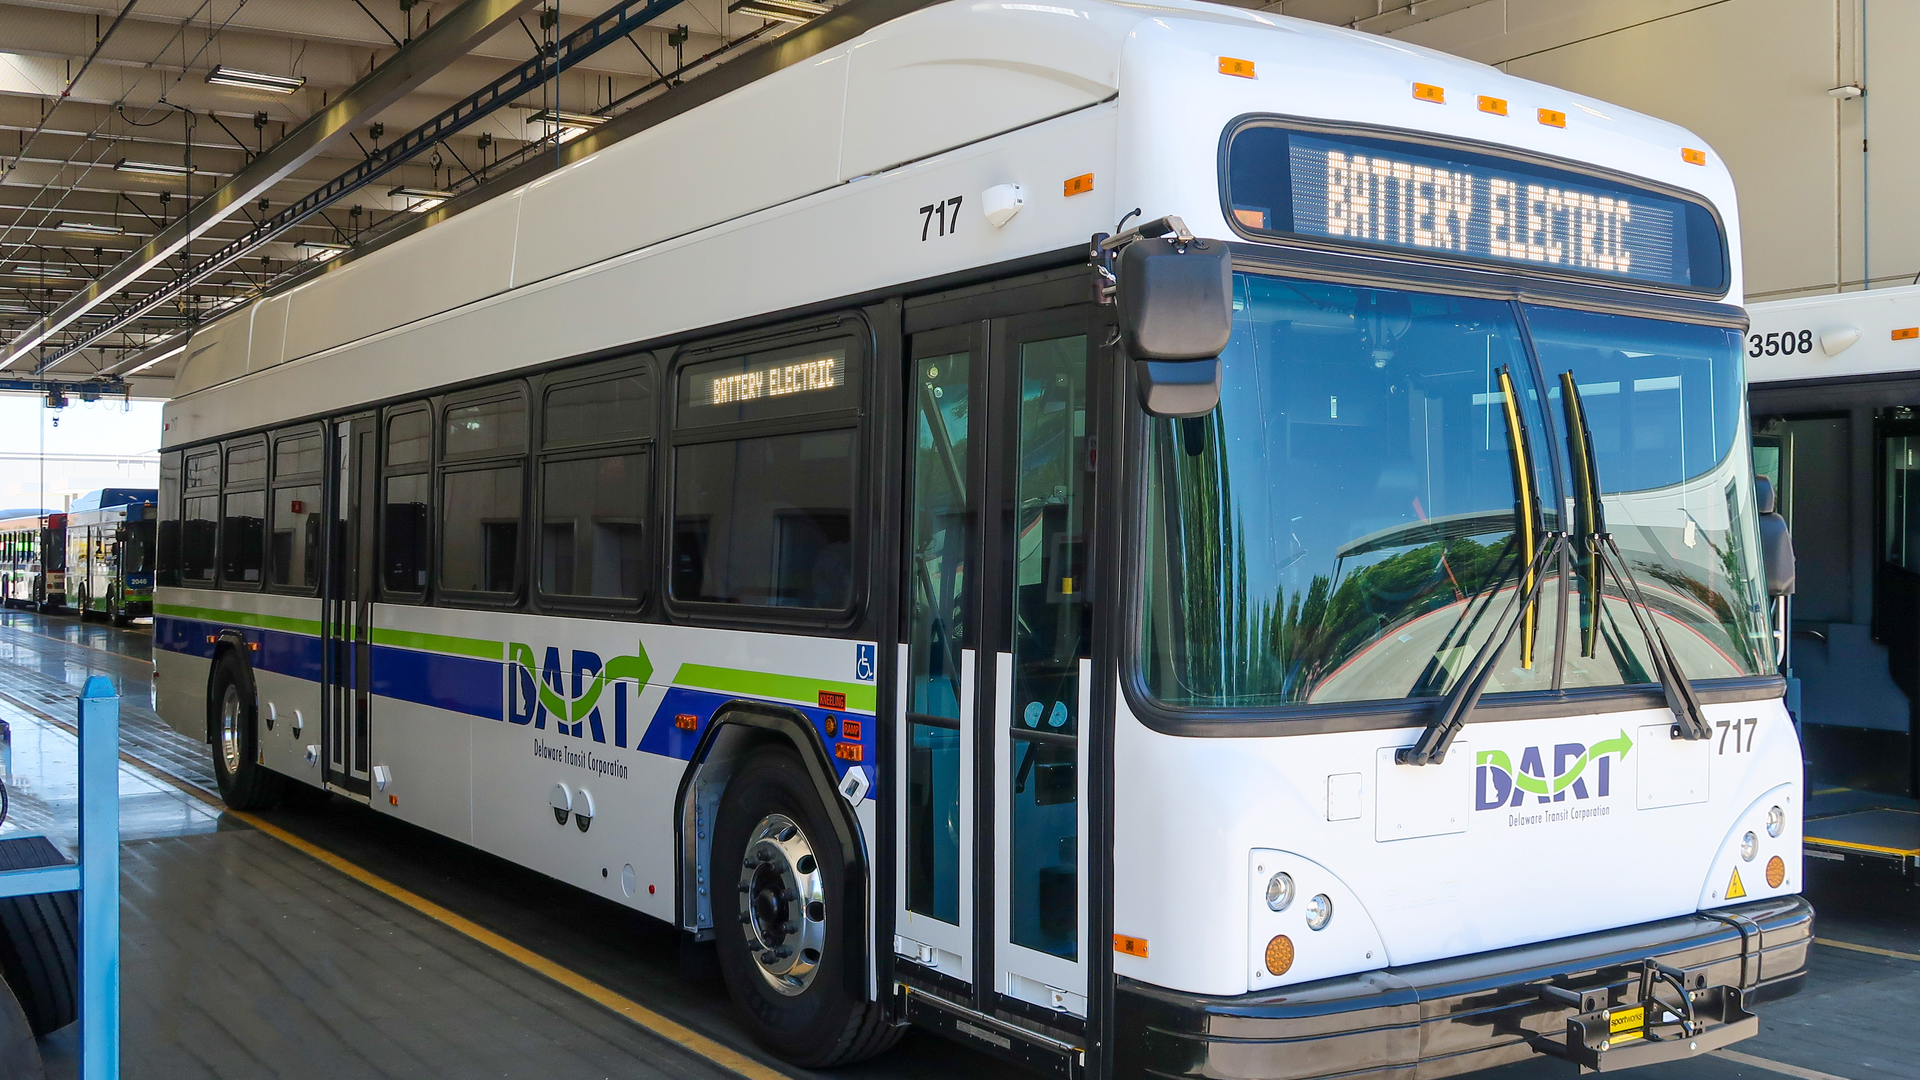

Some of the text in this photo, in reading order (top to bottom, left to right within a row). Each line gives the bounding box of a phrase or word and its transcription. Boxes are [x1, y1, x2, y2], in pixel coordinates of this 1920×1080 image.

[919, 195, 963, 242] 717
[1328, 151, 1630, 272] BATTERY ELECTRIC
[1748, 329, 1813, 358] 3508
[713, 358, 834, 405] BATTERY ELECTRIC
[508, 641, 627, 749] DART
[820, 694, 844, 707] KNEELING
[844, 723, 859, 735] RAMP
[1716, 718, 1758, 755] 717
[533, 738, 628, 780] Delaware Transit Corporation
[1475, 742, 1611, 811] DART
[1508, 803, 1610, 828] Delaware Transit Corporation
